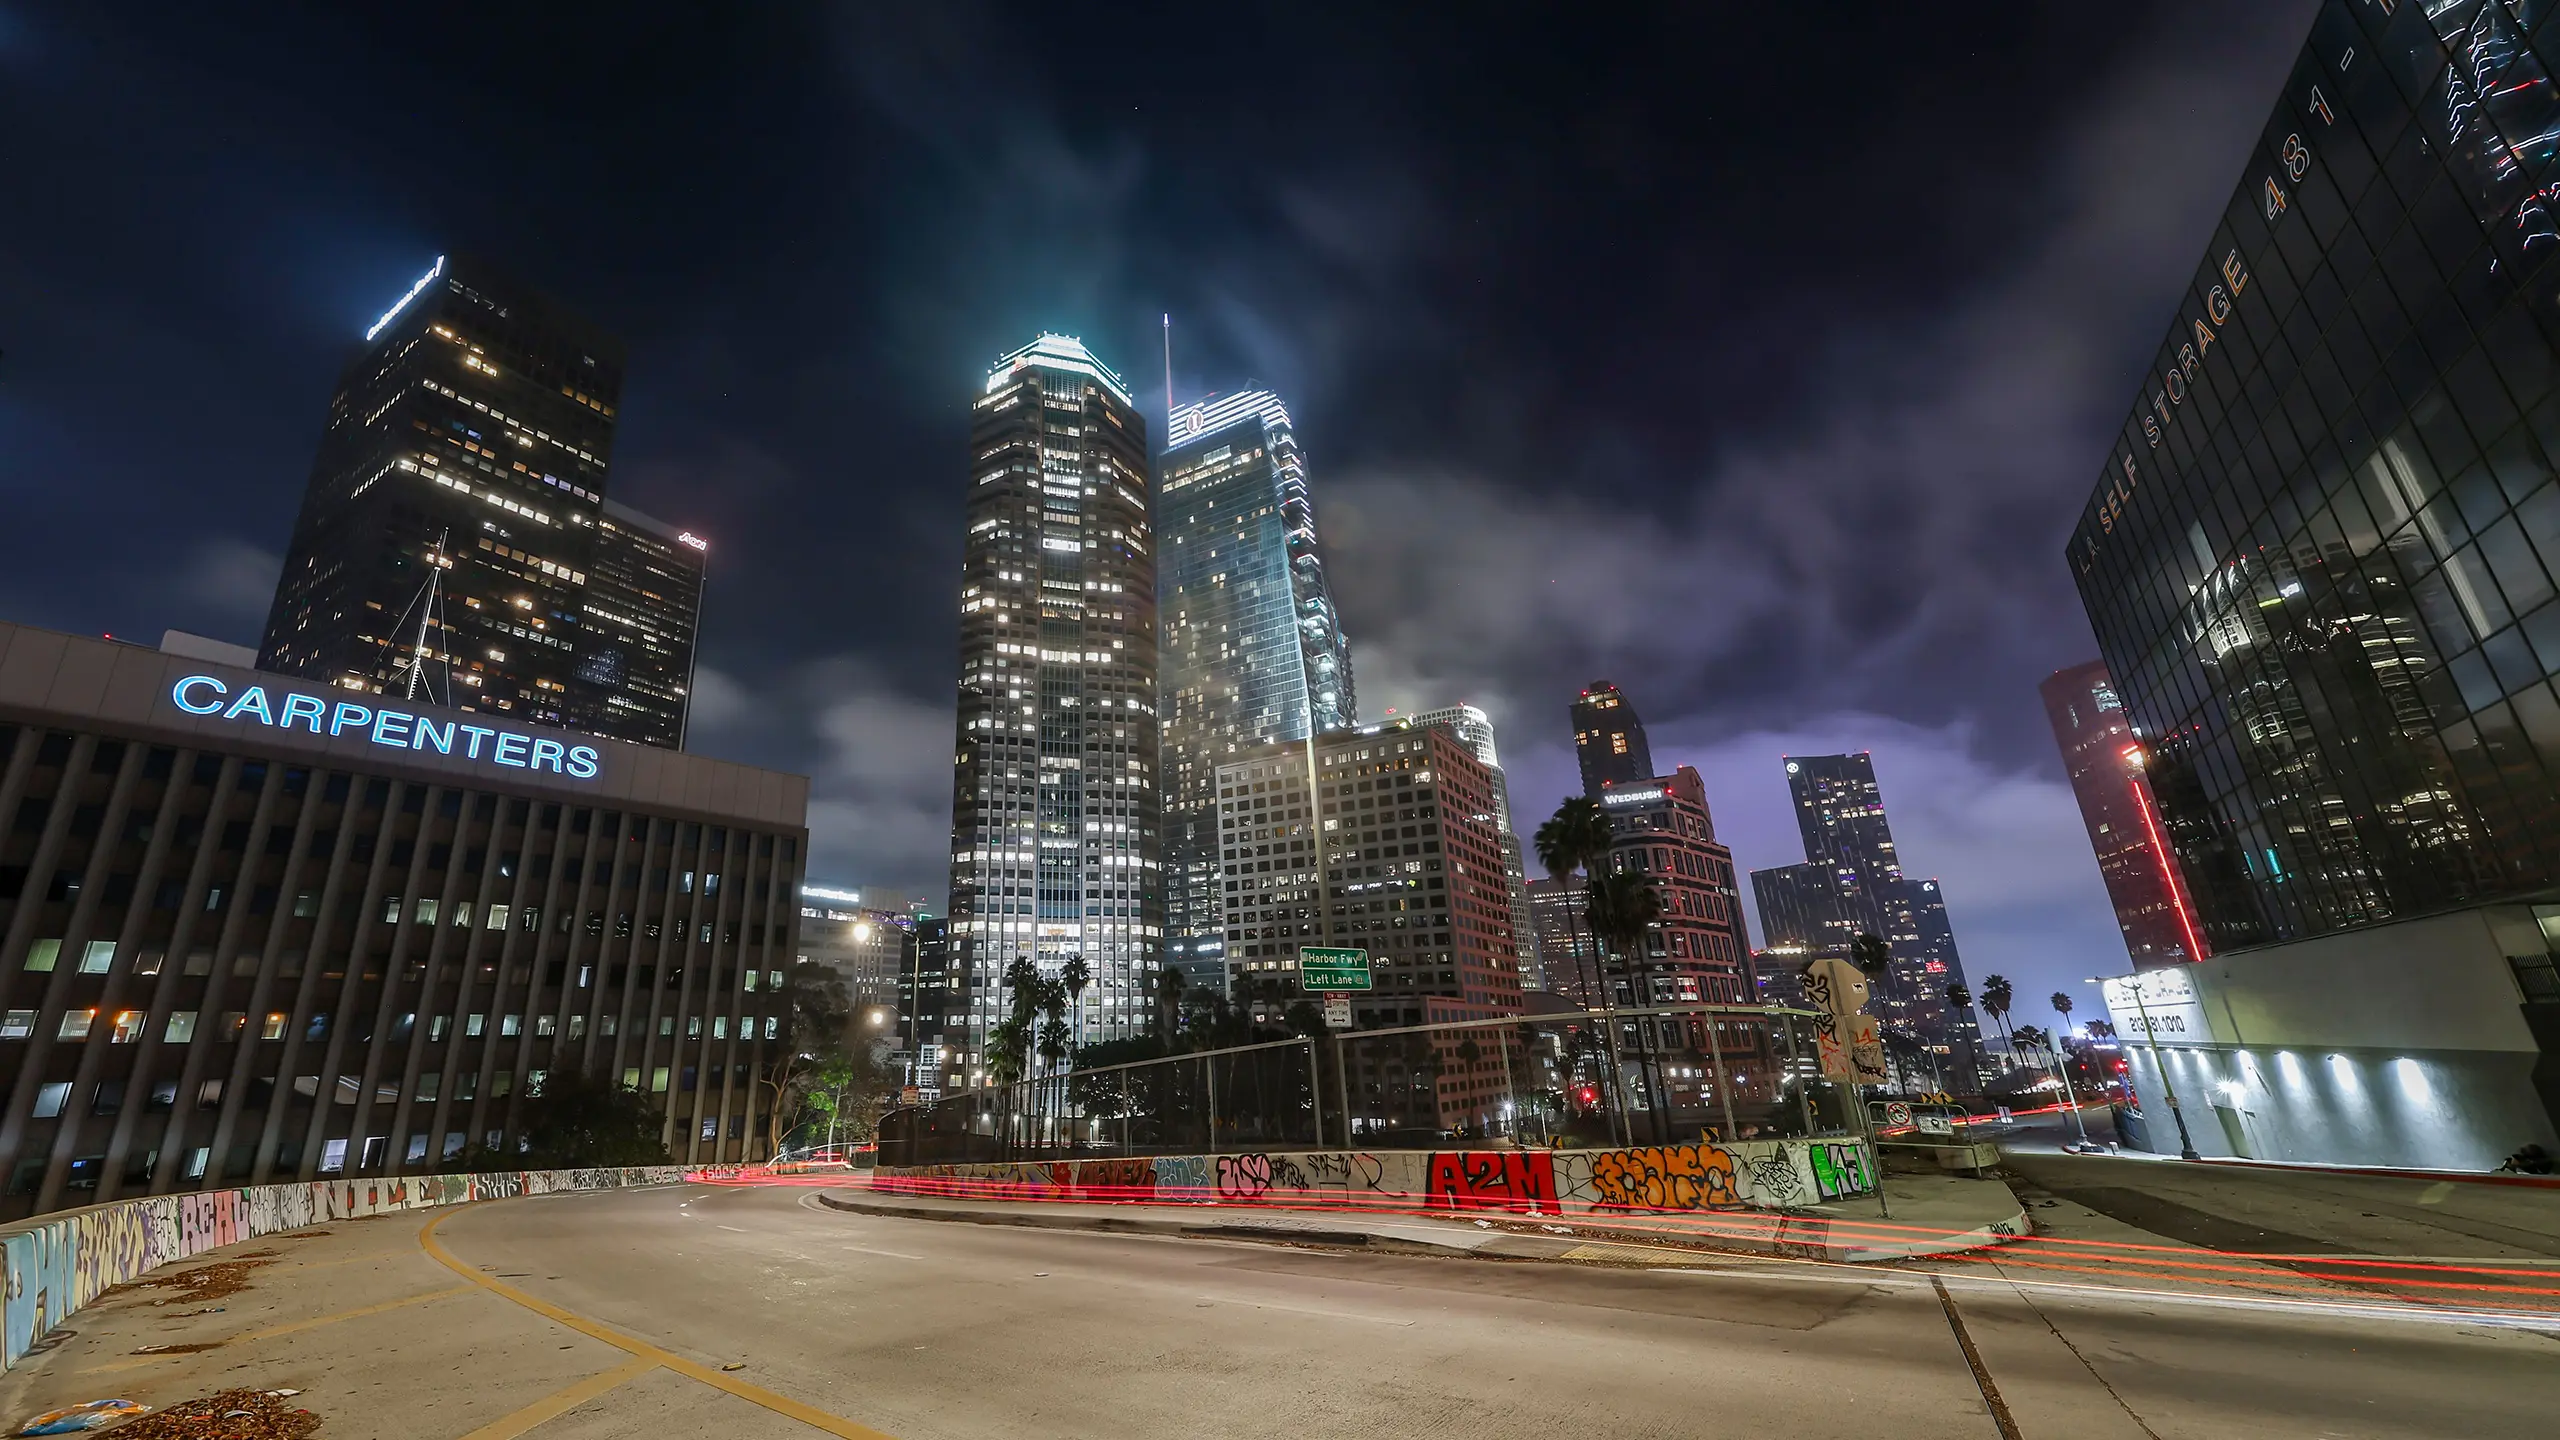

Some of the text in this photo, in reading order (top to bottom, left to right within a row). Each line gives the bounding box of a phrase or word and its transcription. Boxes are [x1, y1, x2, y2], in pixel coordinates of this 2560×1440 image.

[2100, 453, 2137, 535] SELF
[2143, 248, 2249, 449] STORAGE
[172, 674, 600, 779] CARPENTERS
[1604, 789, 1662, 804] WEDBUSH
[1308, 952, 1359, 967] Harbor Fwy
[1310, 972, 1353, 985] Left Lane
[1424, 1150, 1563, 1215] A2M
[179, 1189, 250, 1258] REAL
